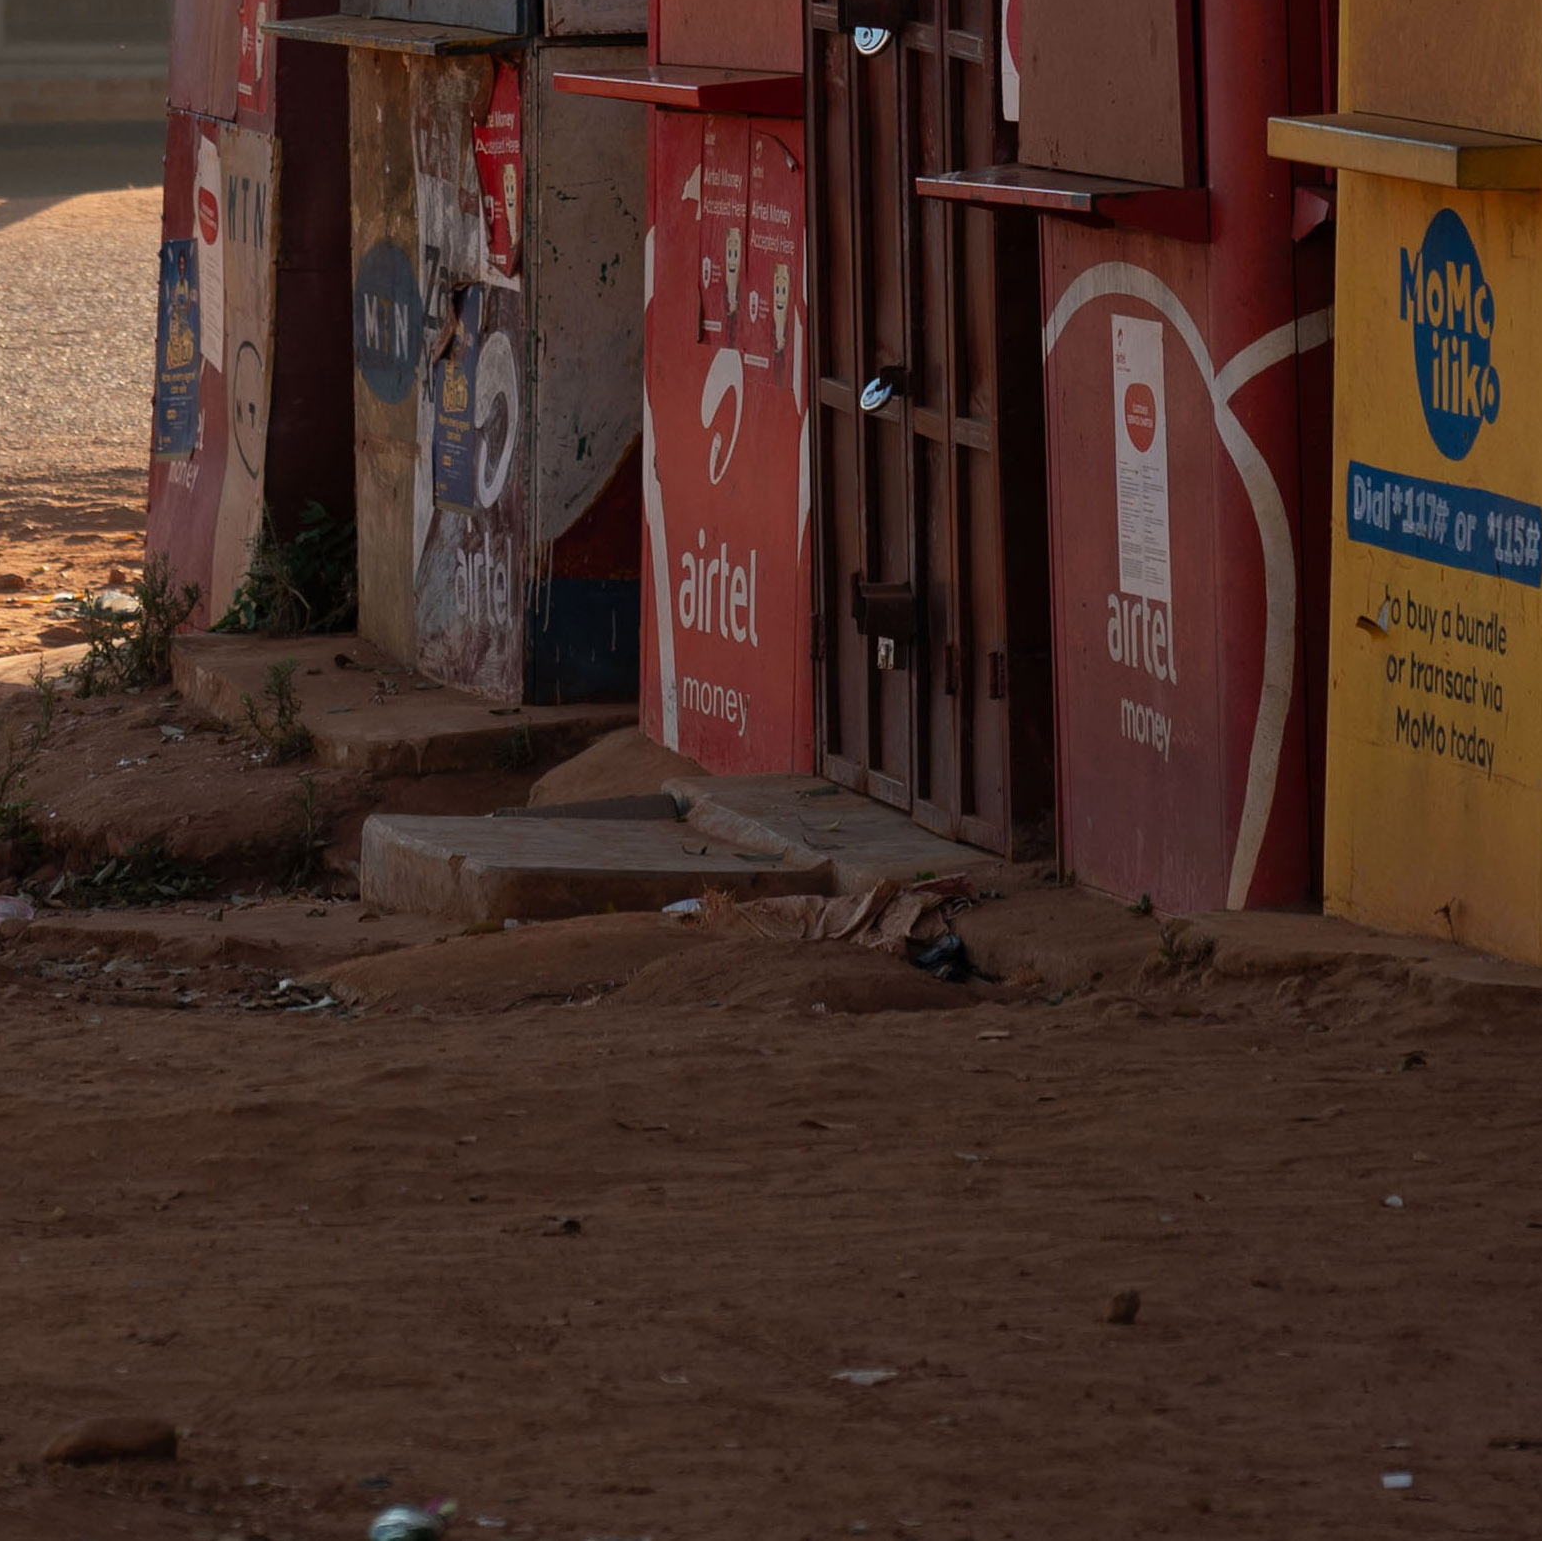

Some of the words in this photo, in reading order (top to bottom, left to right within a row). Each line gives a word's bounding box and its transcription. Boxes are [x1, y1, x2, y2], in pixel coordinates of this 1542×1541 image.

[227, 174, 267, 250] MTN
[363, 292, 409, 361] MTN
[1454, 511, 1477, 552] or
[679, 528, 759, 649] airtel
[1406, 589, 1439, 646] buy
[1441, 608, 1452, 639] a
[1456, 602, 1509, 657] bundle
[1107, 590, 1178, 687] airtel
[682, 673, 750, 739] money
[1385, 652, 1406, 684] or
[1410, 650, 1478, 706] transact
[1480, 672, 1505, 714] via
[1120, 696, 1172, 765] money
[1395, 705, 1447, 757] MoMo
[1450, 720, 1496, 782] today
